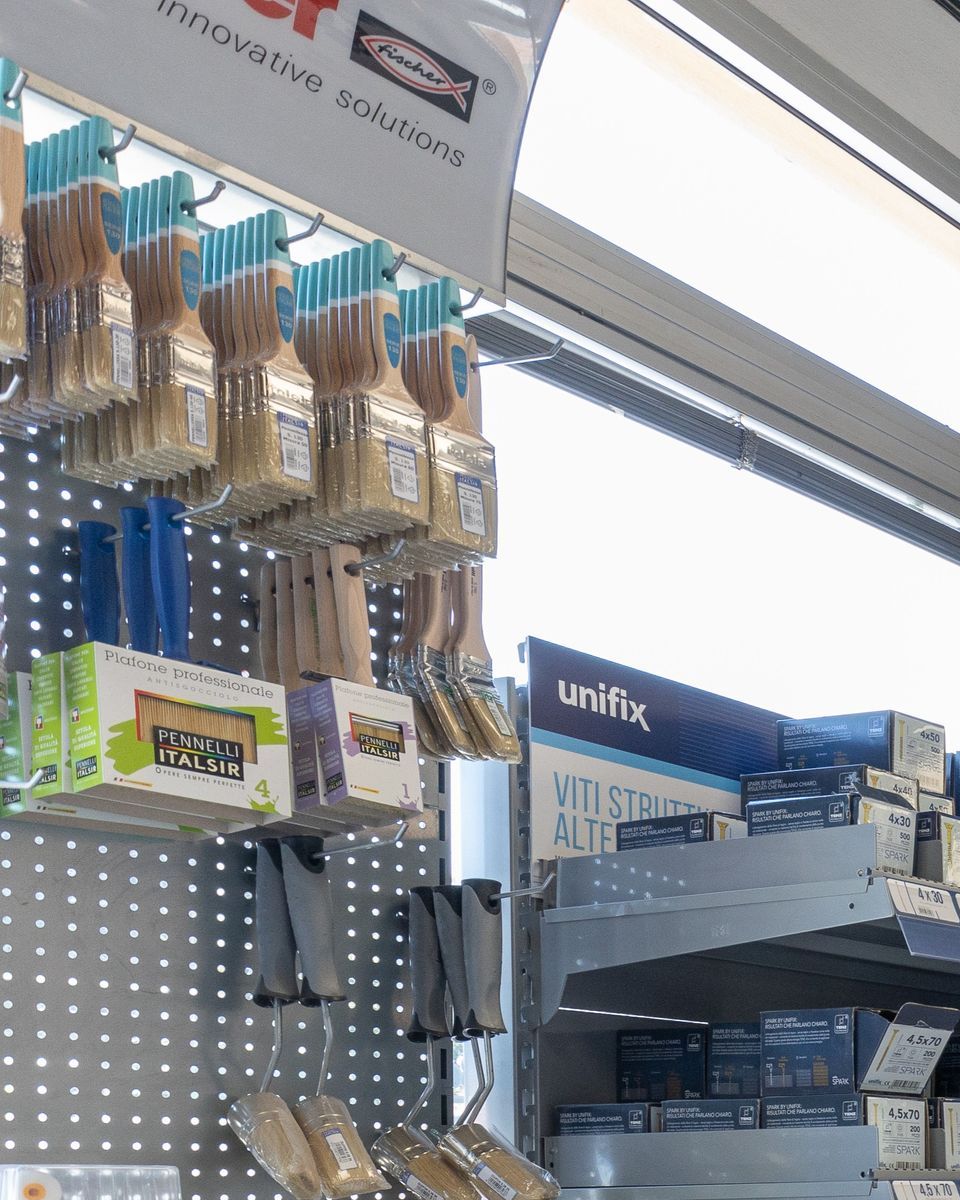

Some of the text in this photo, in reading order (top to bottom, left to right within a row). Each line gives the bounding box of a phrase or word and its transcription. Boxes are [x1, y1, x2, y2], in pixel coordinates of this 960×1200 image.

[377, 43, 445, 87] fischer
[157, 0, 323, 94] innovative
[336, 88, 466, 168] solutions
[104, 650, 274, 700] Plafone professionale
[558, 679, 650, 732] unifix
[158, 729, 239, 758] PENNELLI
[360, 735, 399, 750] PENNELLI
[361, 744, 399, 759] ITALSIR
[157, 749, 241, 777] ITALSIR
[255, 779, 270, 798] 4
[553, 771, 599, 815] VITI
[893, 783, 913, 796] 4x40
[888, 813, 911, 828] 4x30
[906, 1034, 942, 1046] 4,5x70
[889, 1108, 919, 1120] 4,5x70
